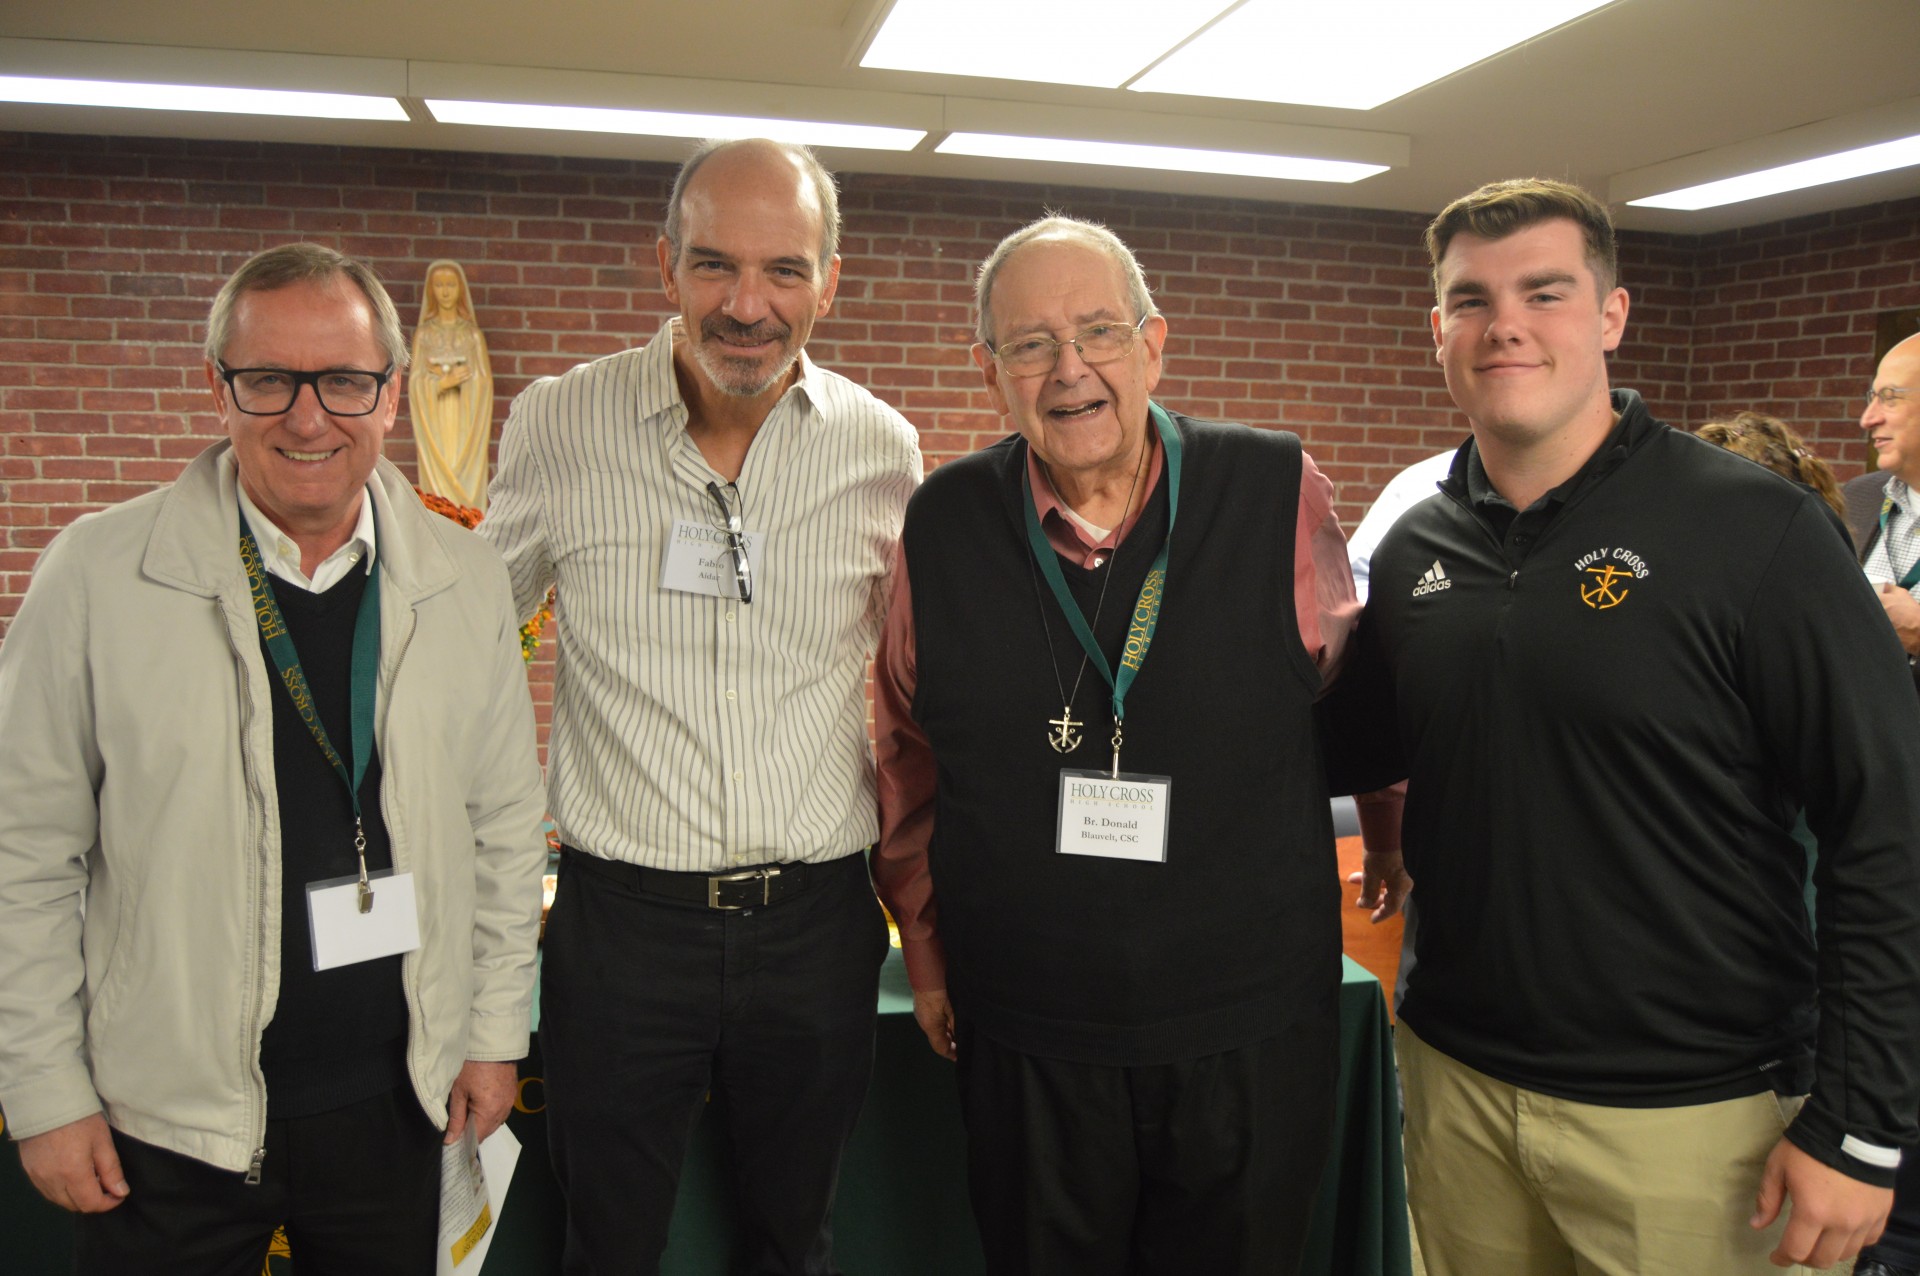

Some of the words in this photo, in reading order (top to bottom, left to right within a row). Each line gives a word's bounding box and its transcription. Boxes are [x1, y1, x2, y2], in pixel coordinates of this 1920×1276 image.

[678, 524, 713, 542] HOLY
[1574, 547, 1609, 572] HOLY
[1612, 547, 1649, 579] CROSS
[1412, 579, 1452, 597] adidas
[252, 592, 280, 641] HOLY
[1121, 620, 1146, 669] HOLY
[1135, 569, 1159, 623] CROSS
[281, 667, 314, 722] CROSS
[1071, 783, 1109, 800] HOLY
[1110, 786, 1155, 804] CROSS
[1083, 816, 1099, 827] Br.
[1101, 818, 1138, 830] Donald
[1081, 831, 1118, 843] Blauvelt,
[1120, 834, 1139, 843] CSC
